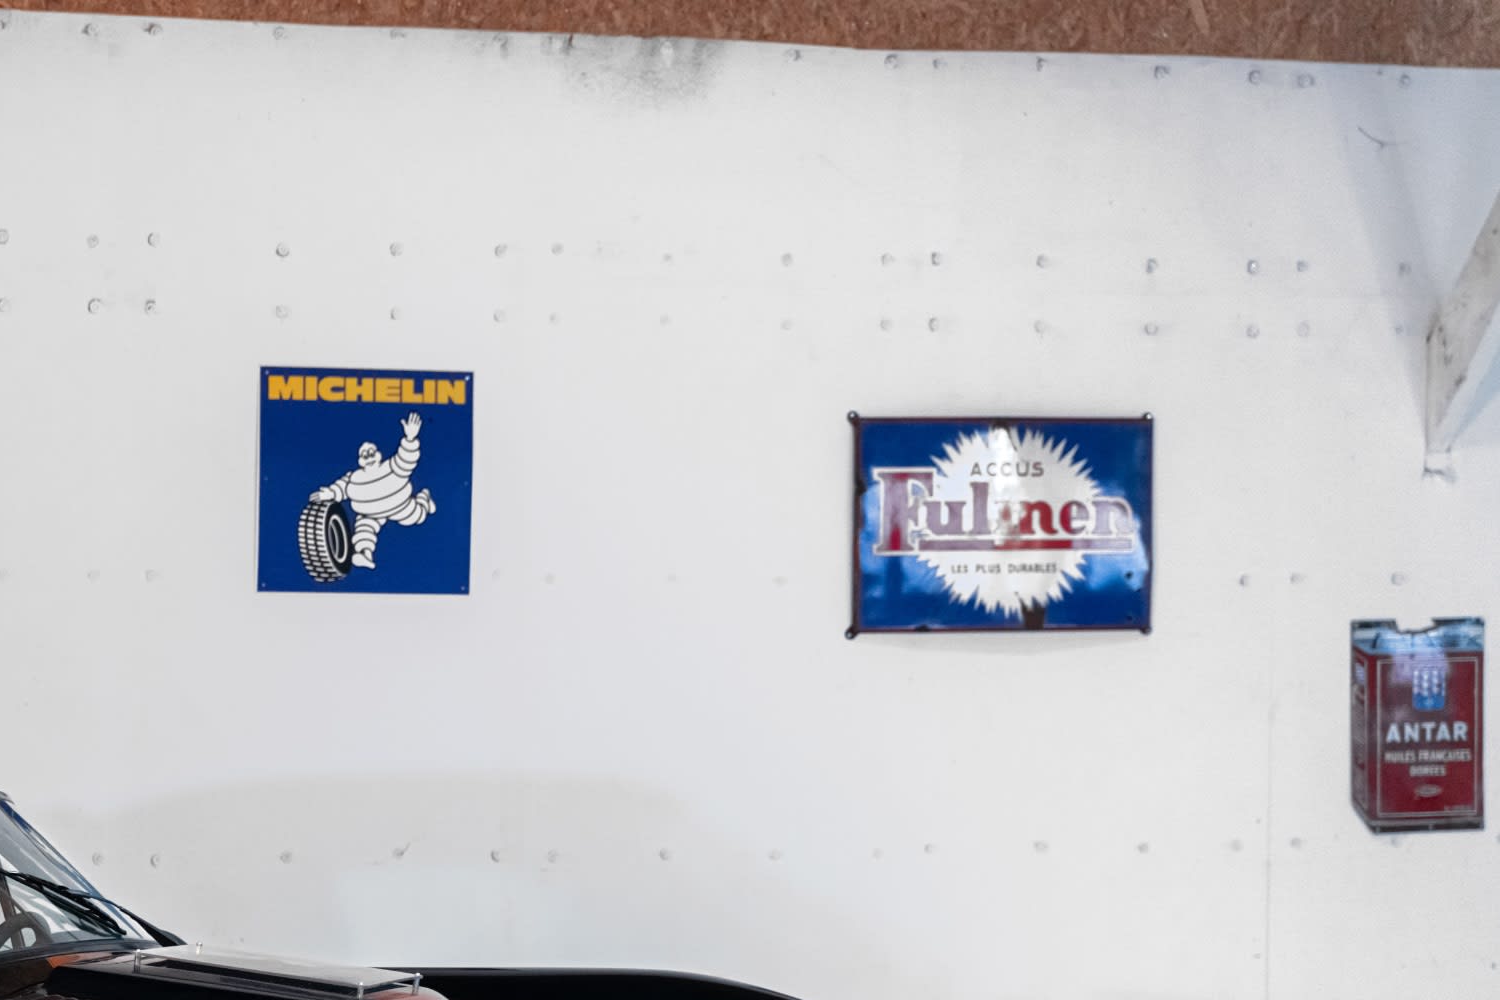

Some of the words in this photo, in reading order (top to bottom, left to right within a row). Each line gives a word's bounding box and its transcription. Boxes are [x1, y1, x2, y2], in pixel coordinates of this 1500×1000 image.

[267, 375, 466, 405] MICHELIN
[970, 461, 1045, 478] ACCUS
[950, 563, 969, 574] LES
[975, 563, 1001, 574] PLUS
[1007, 562, 1058, 574] DURABLES
[1385, 721, 1469, 743] ANTAR
